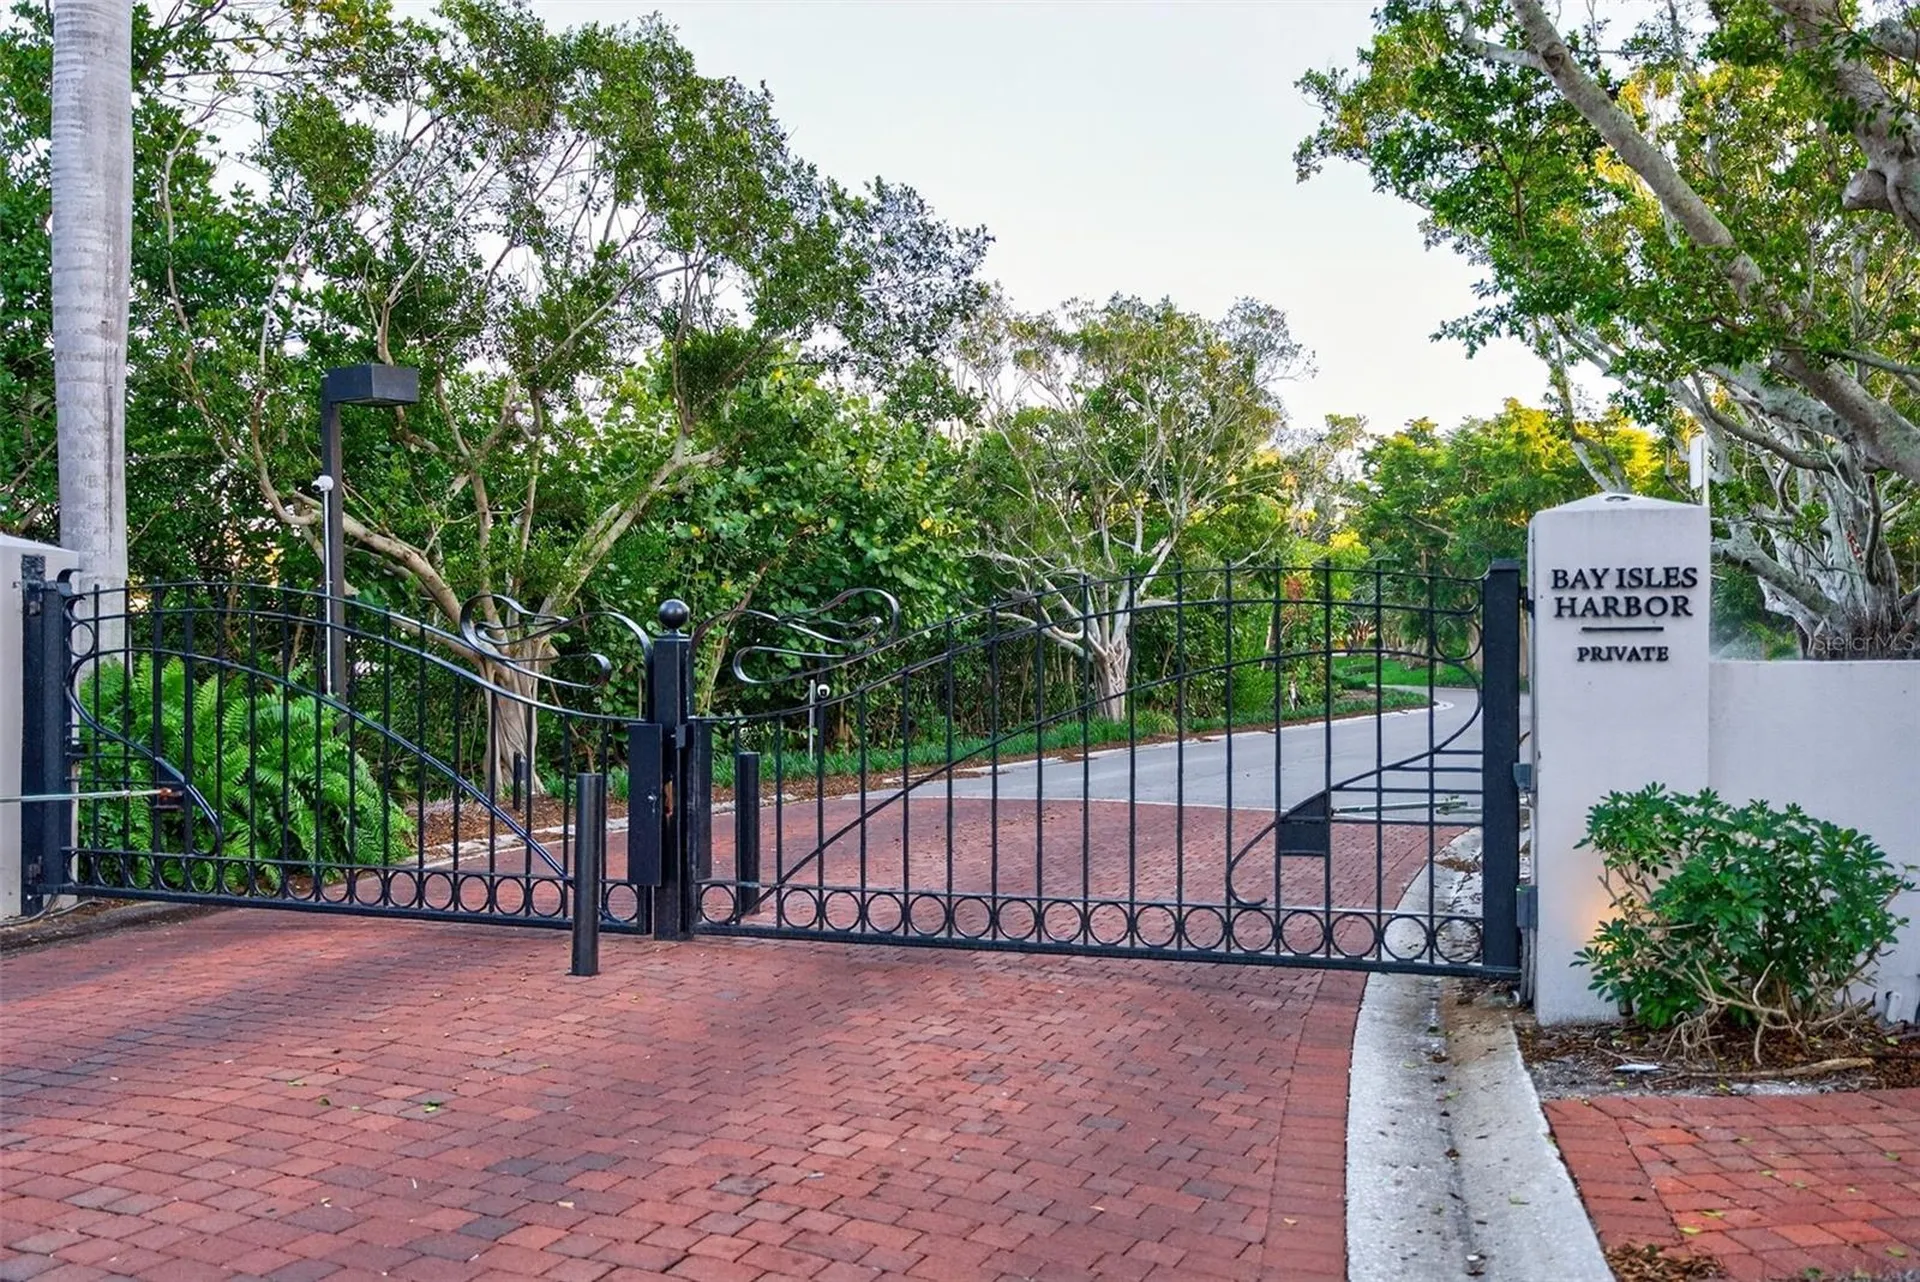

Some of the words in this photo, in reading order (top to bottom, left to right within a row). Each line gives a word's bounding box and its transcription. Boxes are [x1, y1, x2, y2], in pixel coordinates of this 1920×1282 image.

[1551, 568, 1610, 590] BAY
[1615, 567, 1698, 589] ISLES
[1554, 595, 1694, 618] HARBOR
[1577, 646, 1669, 662] PRIVATE
